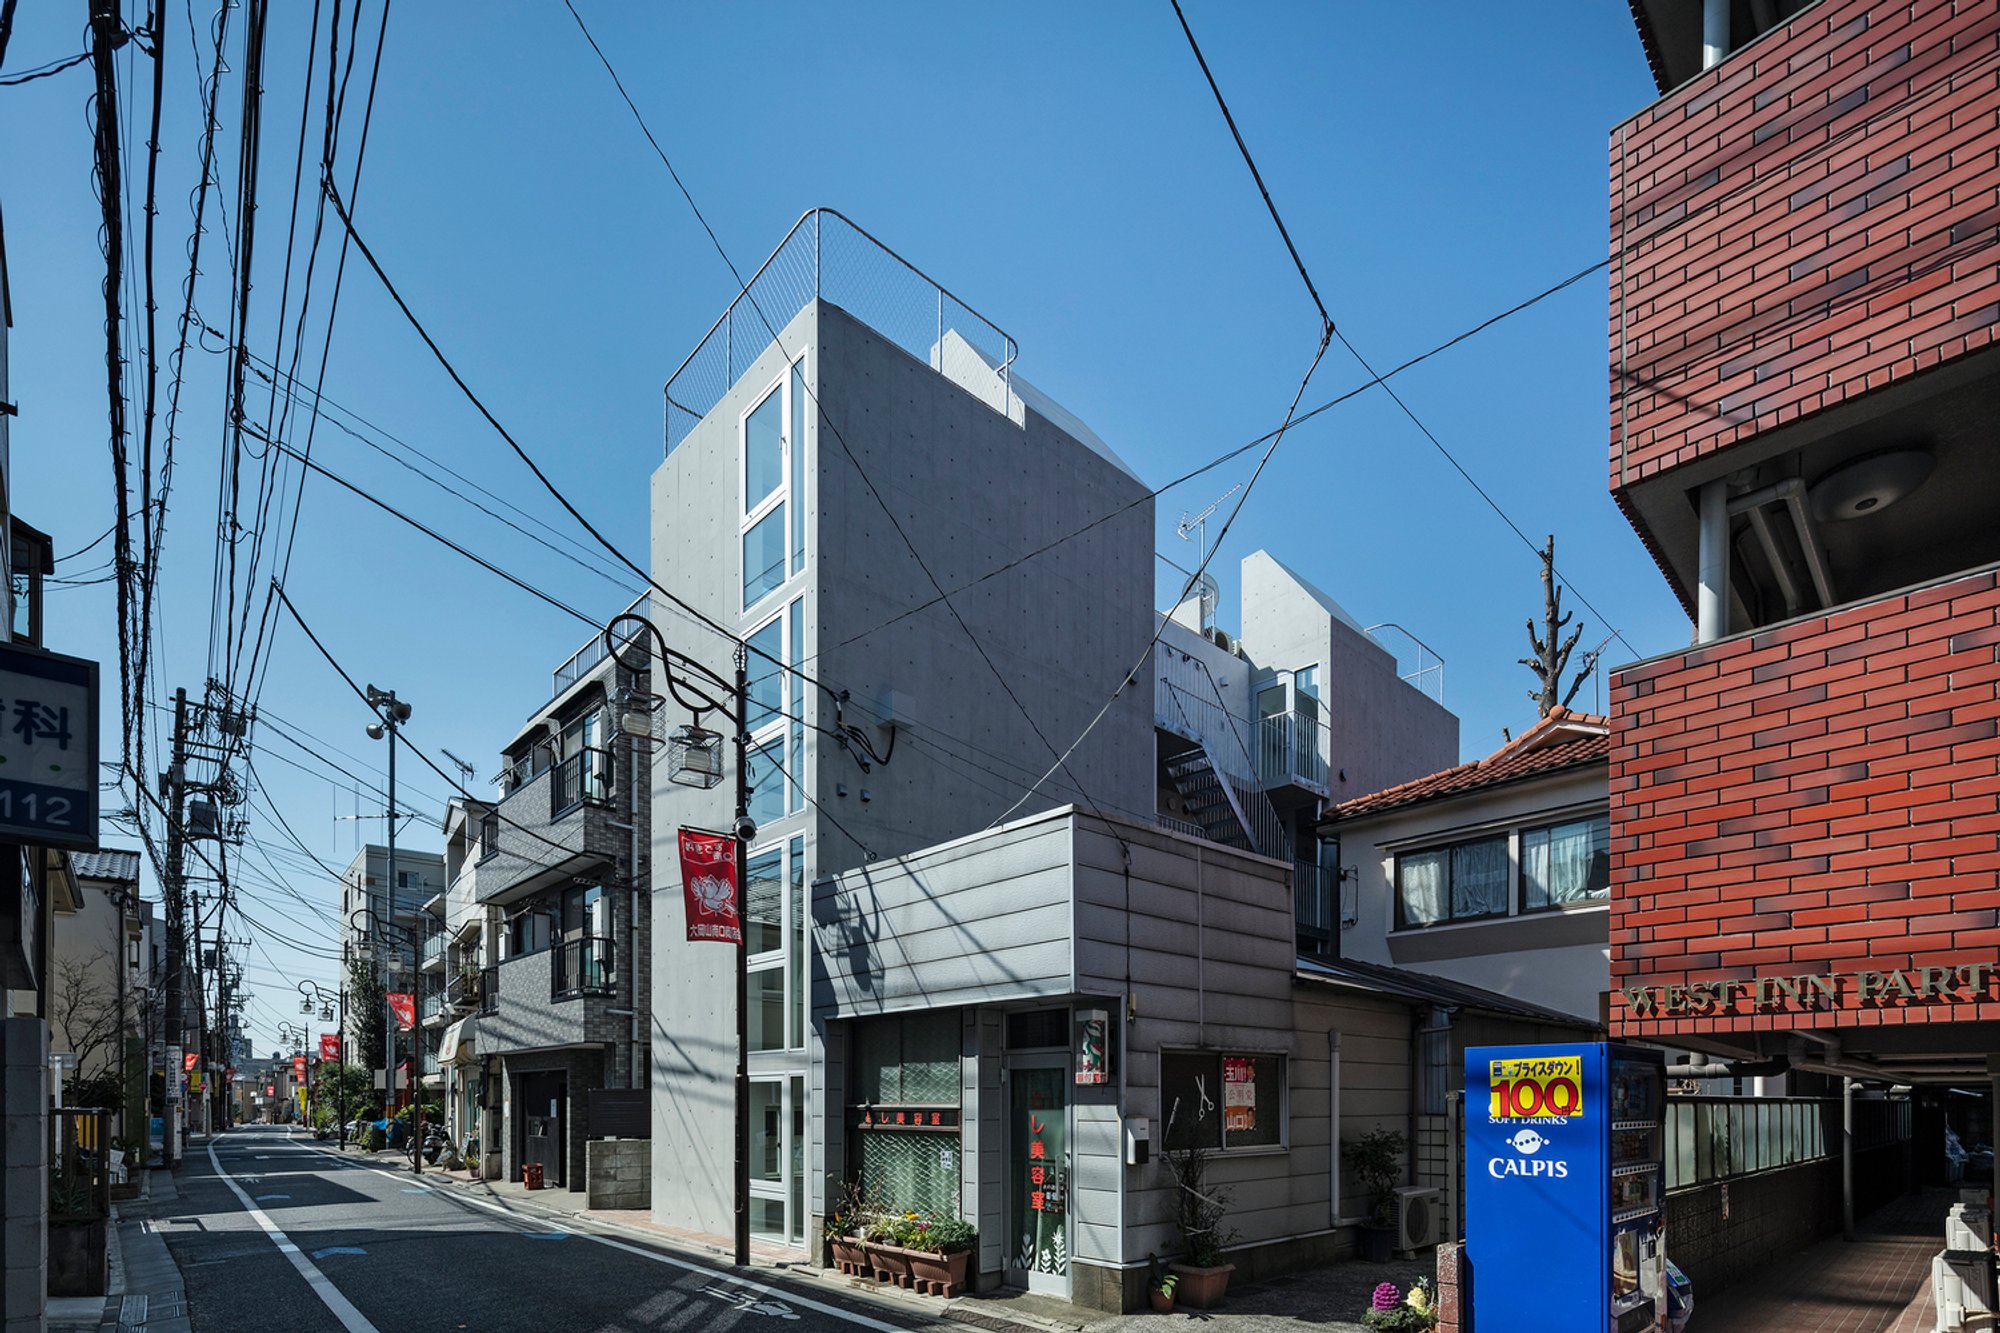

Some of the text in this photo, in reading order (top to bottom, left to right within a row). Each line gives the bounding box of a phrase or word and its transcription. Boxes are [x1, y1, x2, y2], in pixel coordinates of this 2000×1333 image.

[0, 699, 72, 750] 科
[0, 789, 72, 826] 112
[1619, 962, 1994, 1014] WEST INN PART
[1488, 1158, 1568, 1179] CALPIS
